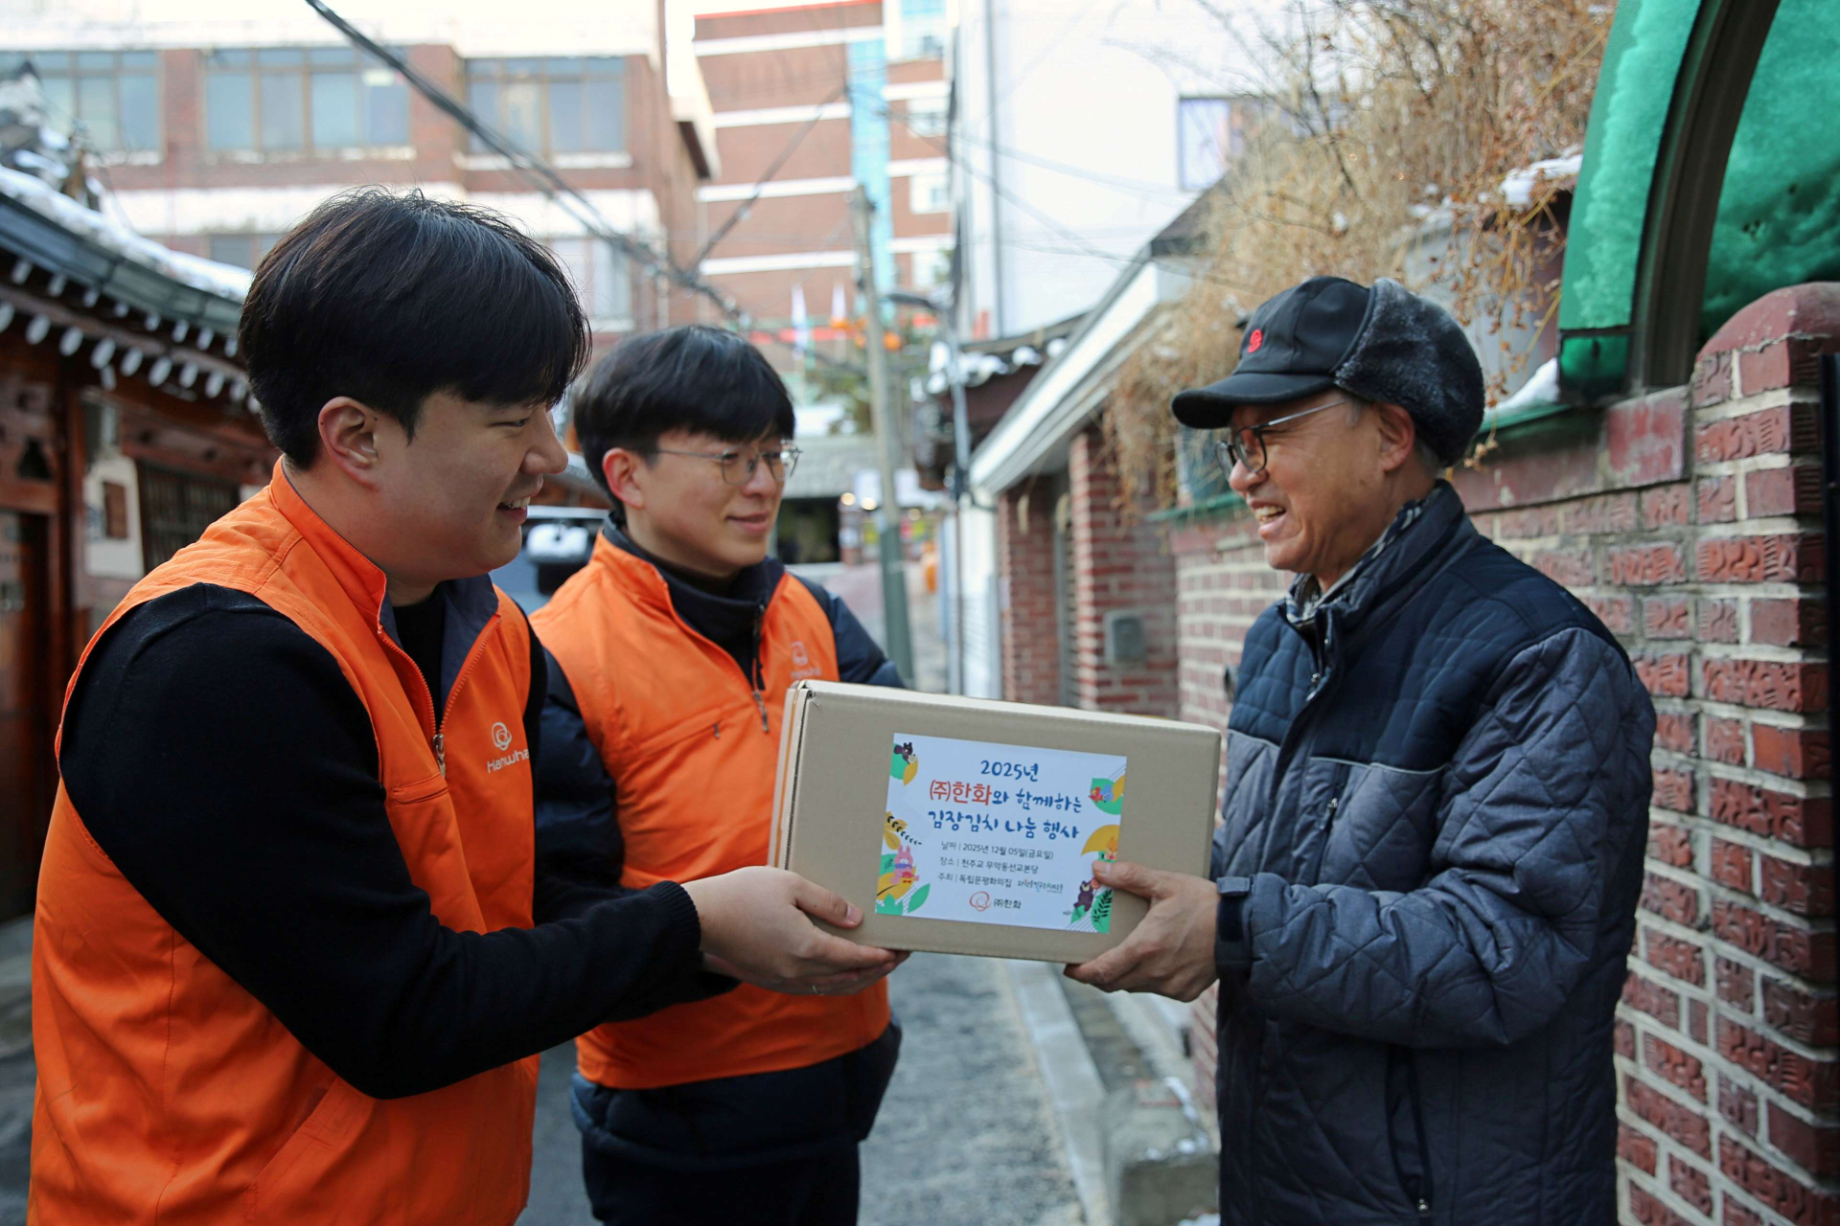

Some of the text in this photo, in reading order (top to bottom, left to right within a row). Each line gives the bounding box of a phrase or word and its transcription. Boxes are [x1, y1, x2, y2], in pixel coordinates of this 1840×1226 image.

[981, 760, 1039, 782] 2025년
[1016, 788, 1082, 813] 함께하는
[928, 810, 1080, 840] 김장김치 나눔 행사
[940, 857, 955, 866] 장소
[961, 859, 984, 868] 천주교
[962, 843, 989, 854] 2025년
[991, 846, 1007, 856] 12월
[1008, 848, 1054, 860] 05일(금요일)
